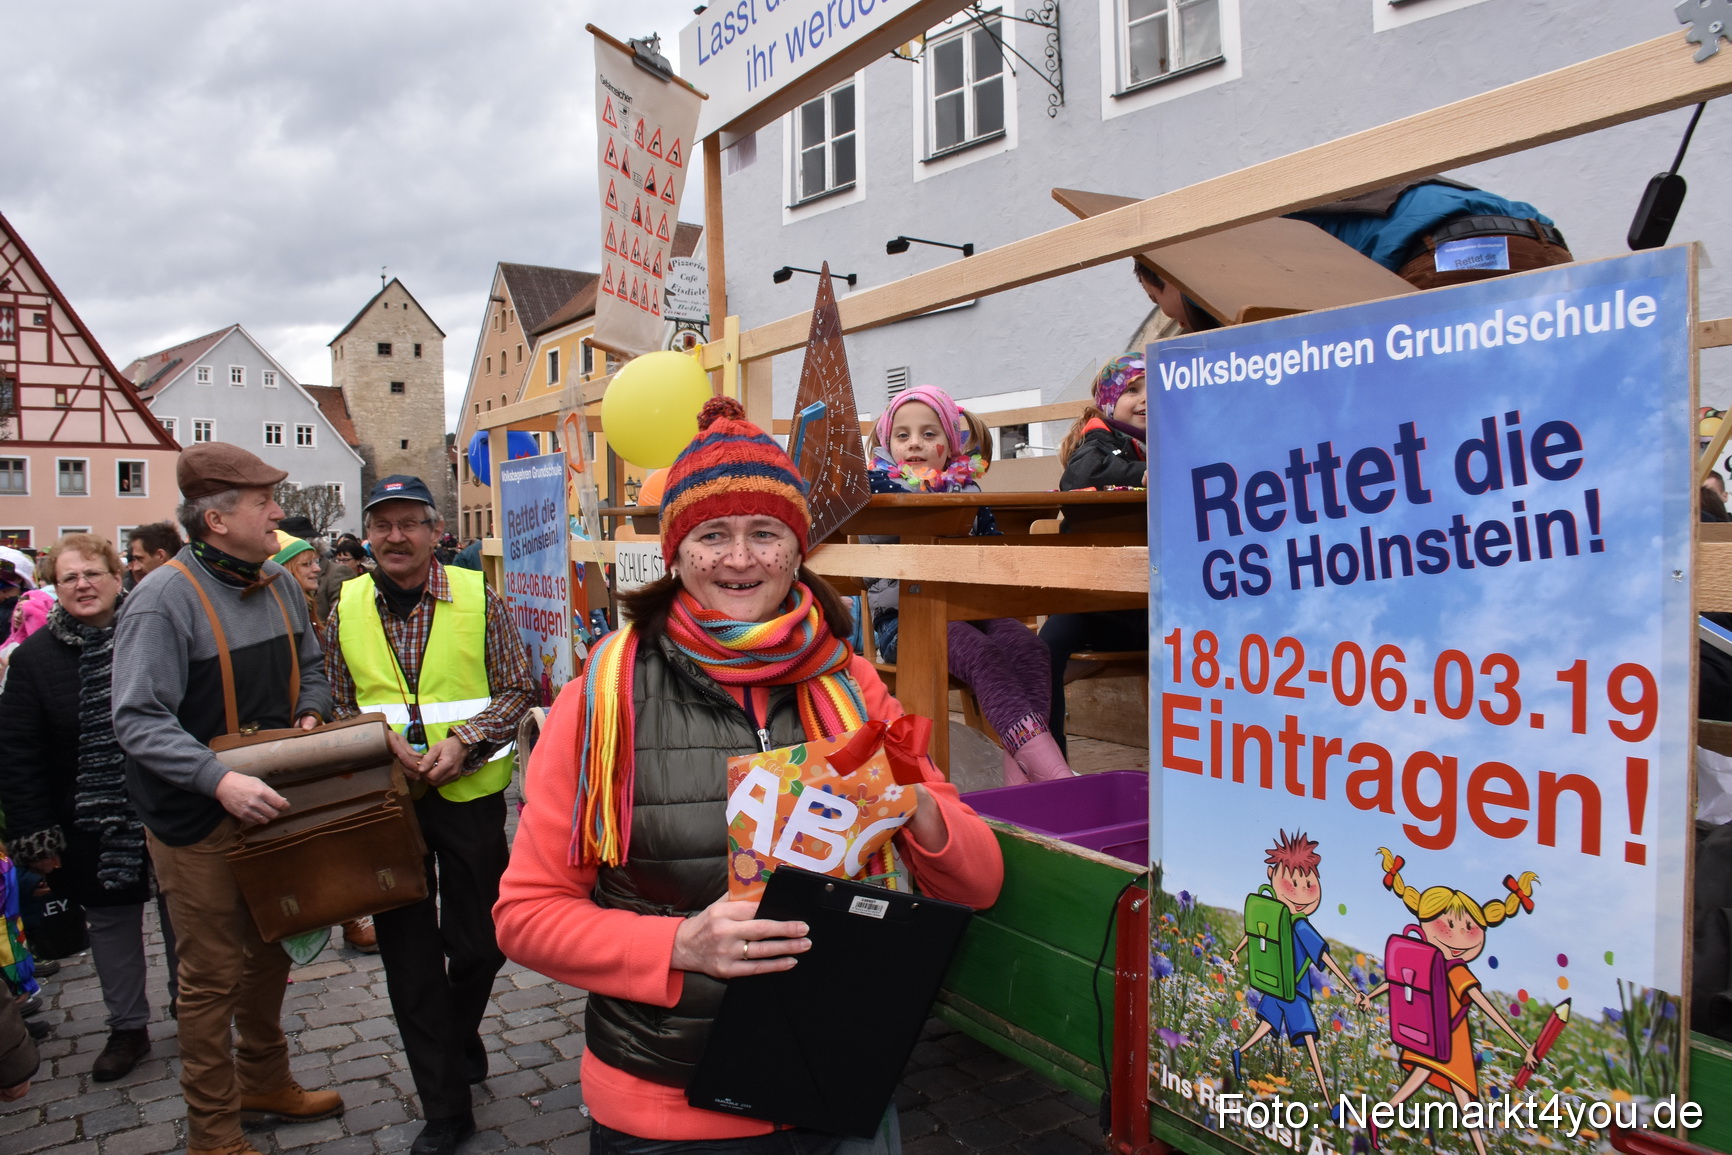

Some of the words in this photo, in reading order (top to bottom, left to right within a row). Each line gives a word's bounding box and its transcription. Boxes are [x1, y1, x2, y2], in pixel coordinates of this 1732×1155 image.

[746, 41, 777, 92] ihr
[671, 259, 706, 272] Pizzeria
[680, 273, 698, 283] Café
[1455, 254, 1483, 268] Rettet
[1159, 336, 1374, 390] Volksbegehren
[1385, 289, 1657, 361] Grundschule
[501, 469, 531, 483] Volksbegehren
[531, 465, 562, 480] Grundschule
[1191, 421, 1432, 542] Rettet
[1454, 410, 1584, 495] die
[507, 500, 540, 539] Rettet
[541, 497, 556, 522] die
[510, 538, 521, 560] GS
[522, 523, 559, 555] Holnstein!
[1202, 543, 1272, 600] GS
[1286, 488, 1605, 591] Holnstein!
[506, 571, 566, 601] 18.02-06.03.19
[1163, 627, 1659, 743] 18.02-06.03.19
[1161, 691, 1650, 867] Eintragen!
[1161, 1063, 1194, 1100] Ins
